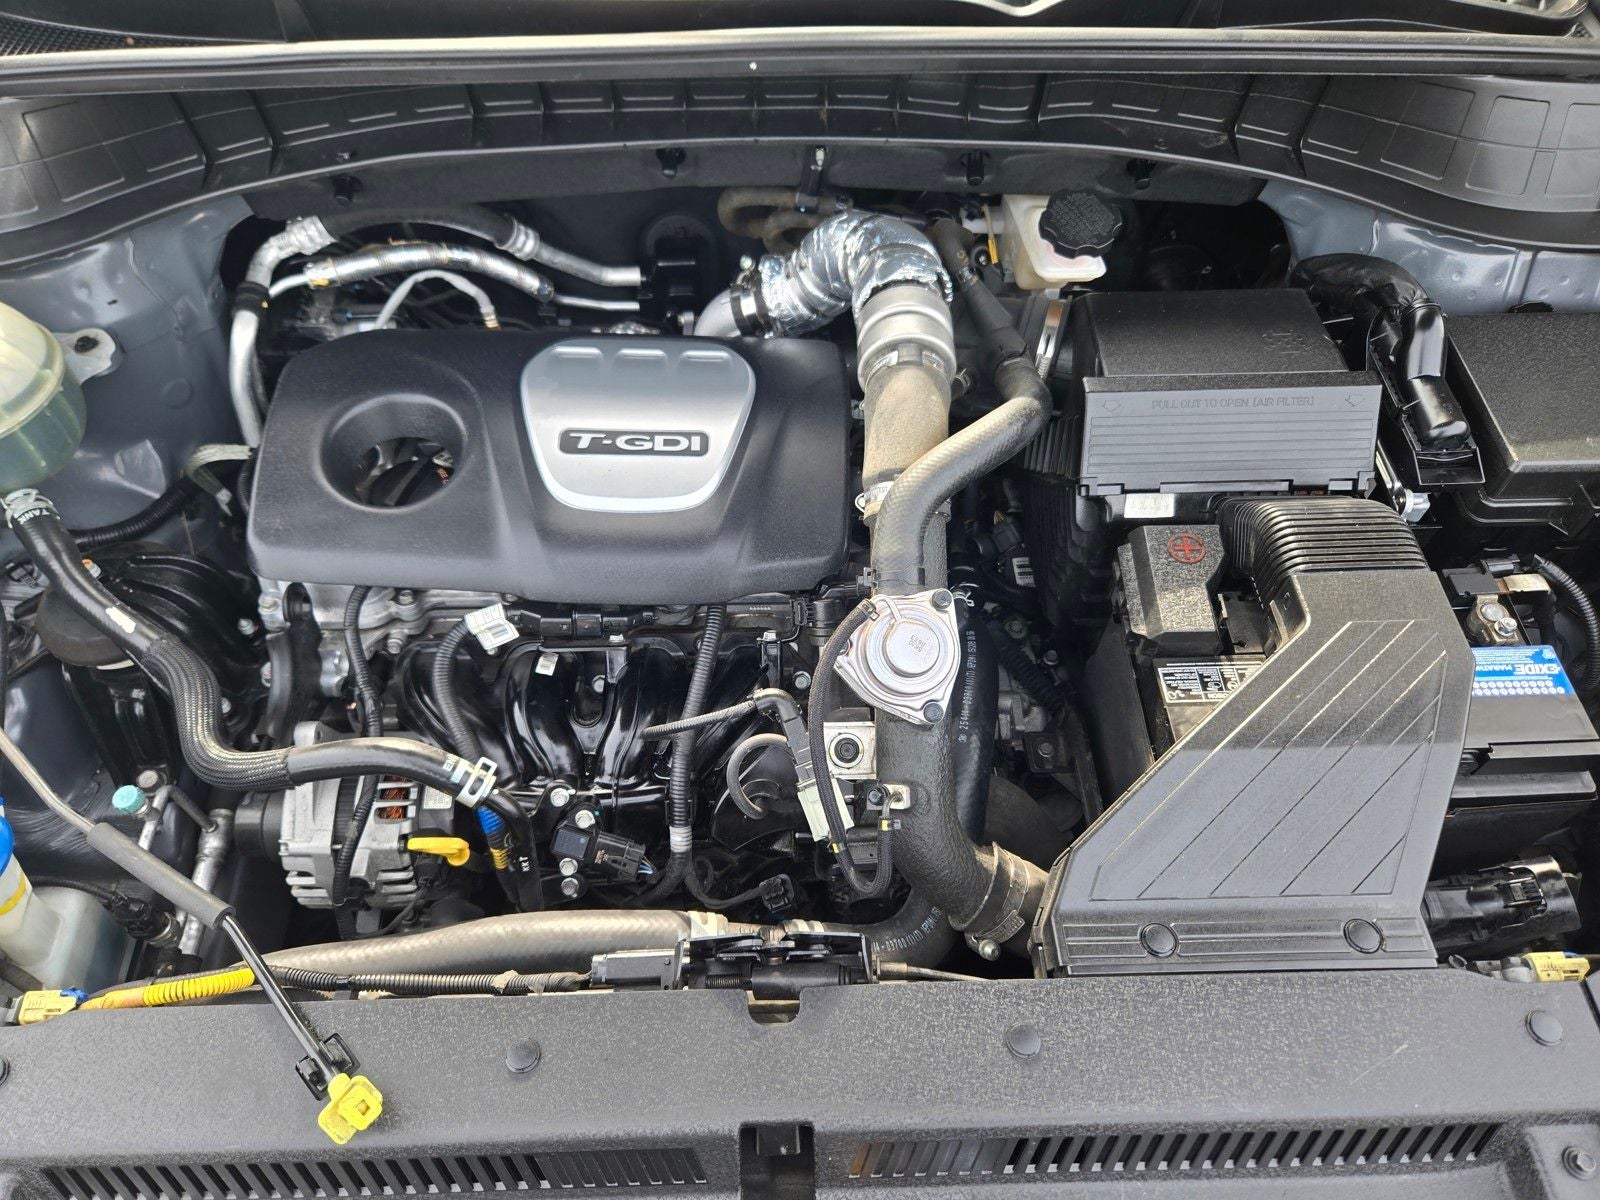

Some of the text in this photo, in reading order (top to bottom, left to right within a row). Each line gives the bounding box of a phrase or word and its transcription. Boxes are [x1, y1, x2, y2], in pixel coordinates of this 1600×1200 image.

[1152, 400, 1178, 409] PULL
[1181, 399, 1200, 409] OUT
[1203, 399, 1218, 408] TO
[1220, 398, 1249, 408] OPEN
[569, 433, 701, 452] T-GDI
[17, 509, 51, 525] TANK
[1513, 663, 1561, 675] EXIDE
